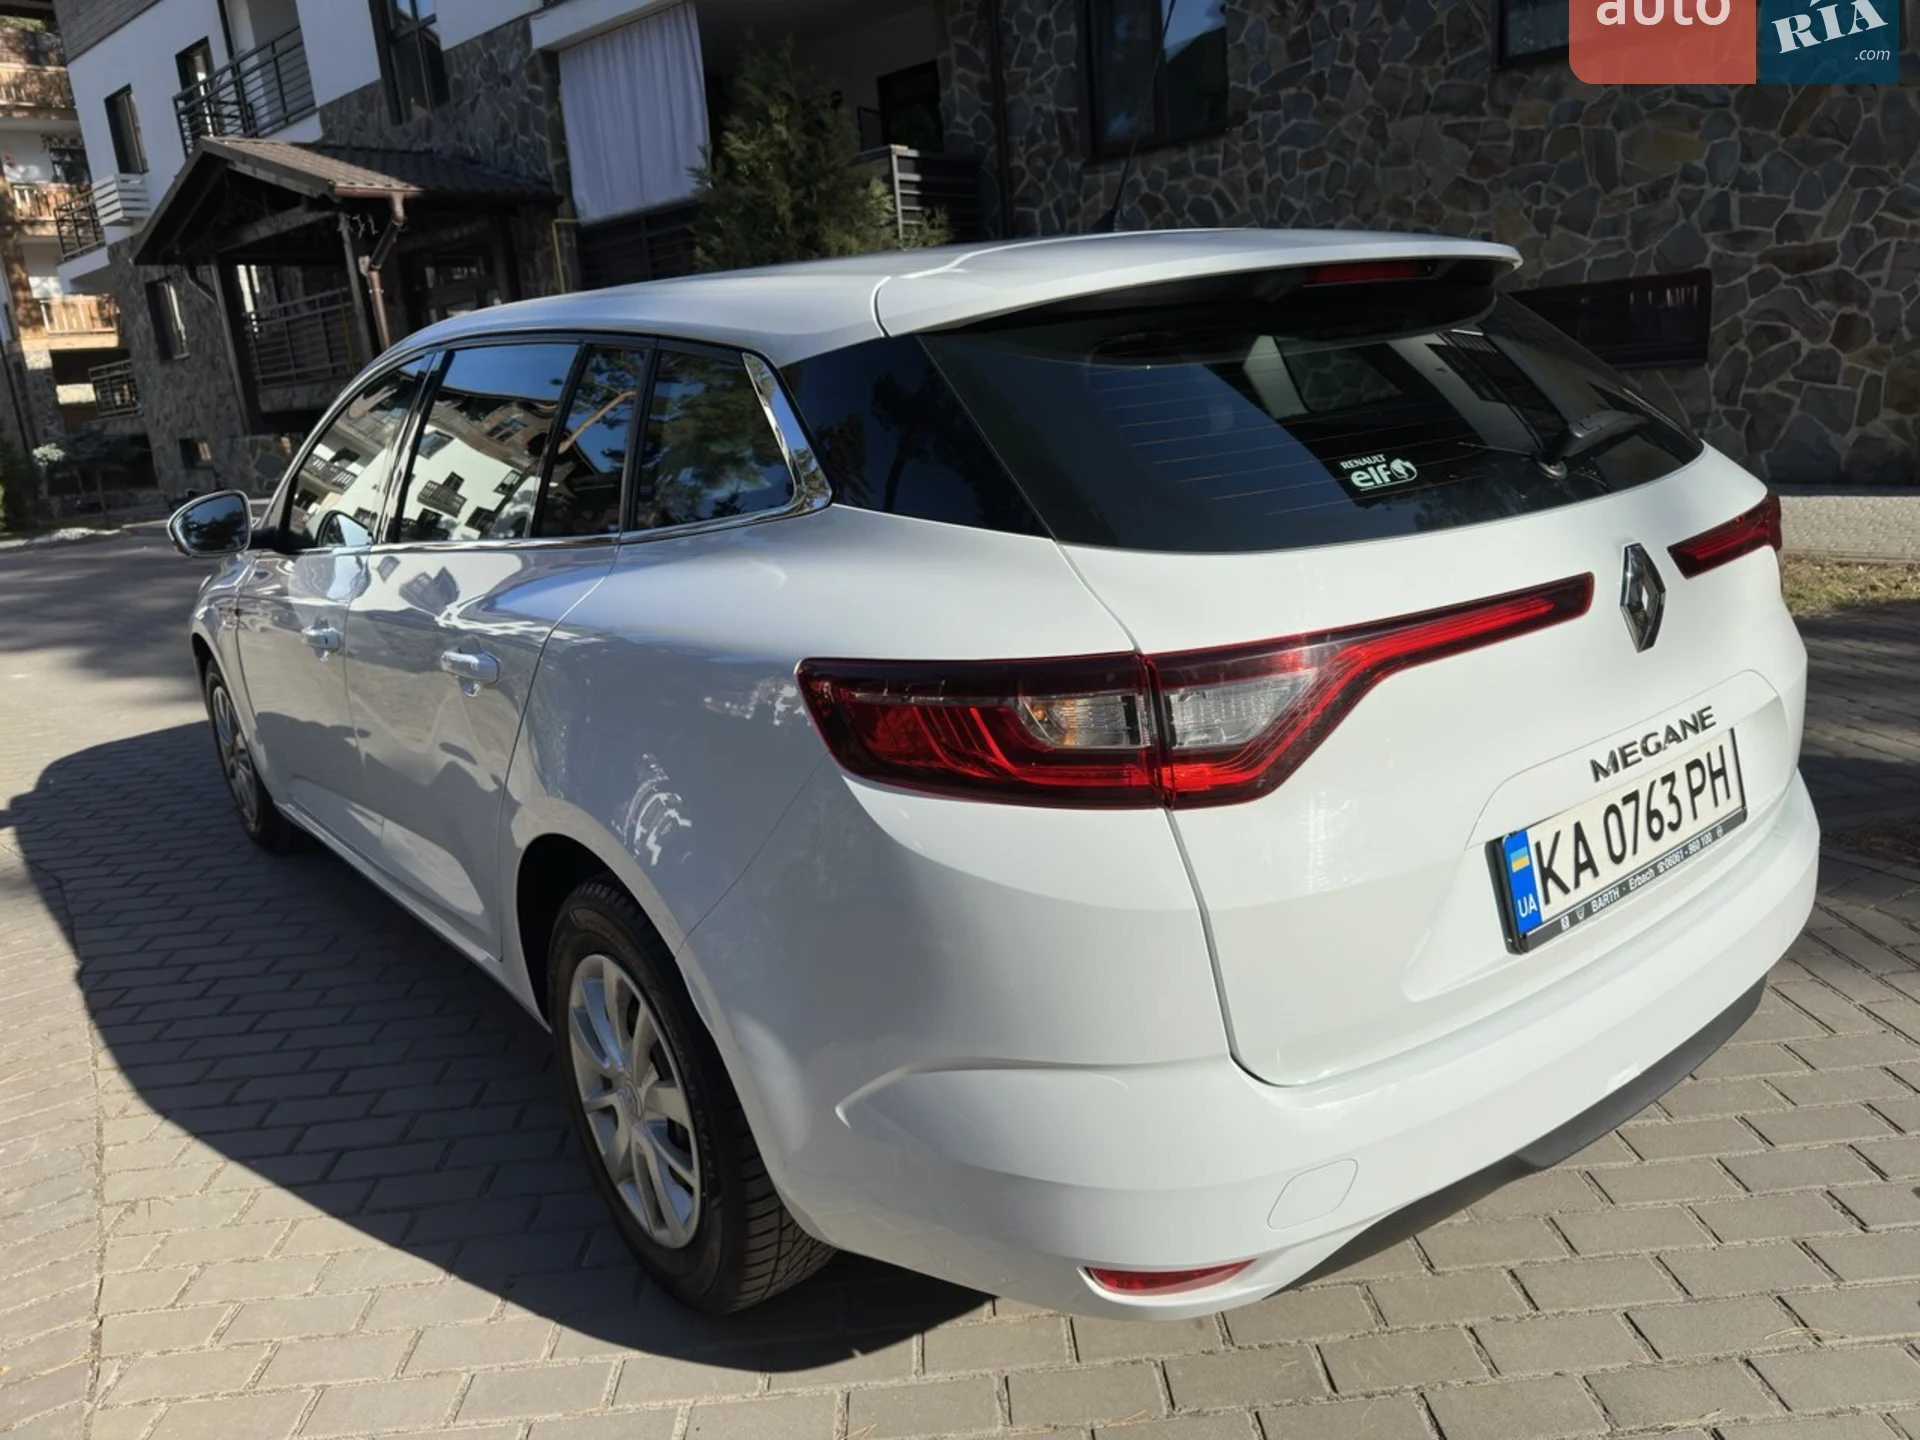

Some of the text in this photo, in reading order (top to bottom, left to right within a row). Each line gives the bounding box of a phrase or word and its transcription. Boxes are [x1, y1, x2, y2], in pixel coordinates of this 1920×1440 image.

[1340, 454, 1386, 469] RENAULT
[1351, 463, 1391, 487] elf
[1590, 705, 1717, 783] MEGANE
[1535, 744, 1731, 906] KA 0763 PH
[1517, 893, 1538, 918] UA
[1591, 886, 1620, 912] BARTH
[1628, 868, 1656, 890] Erbach
